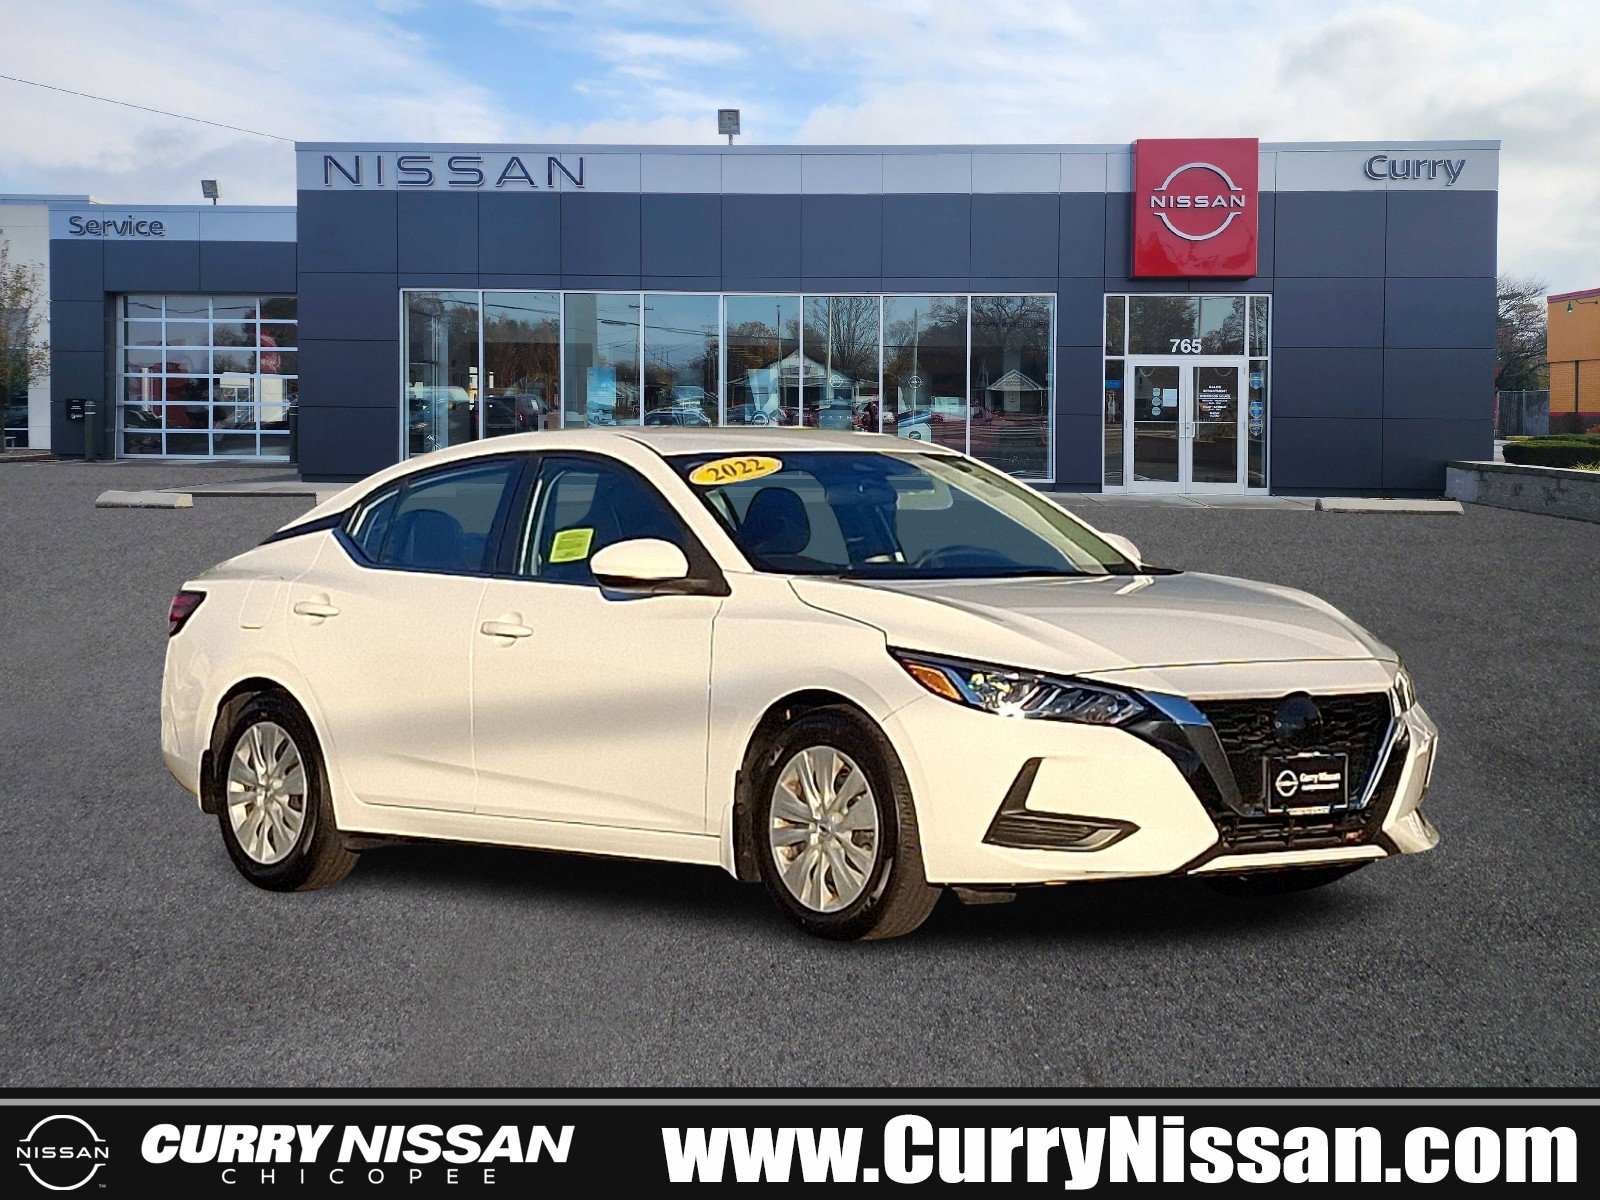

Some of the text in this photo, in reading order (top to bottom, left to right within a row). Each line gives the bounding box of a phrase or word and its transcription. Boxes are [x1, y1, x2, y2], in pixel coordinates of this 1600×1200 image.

[323, 154, 586, 188] NISSAN
[1364, 153, 1467, 186] Curry
[1150, 195, 1246, 208] NISSAN
[68, 214, 165, 237] Service
[1170, 338, 1203, 354] 765
[707, 459, 765, 481] 2022
